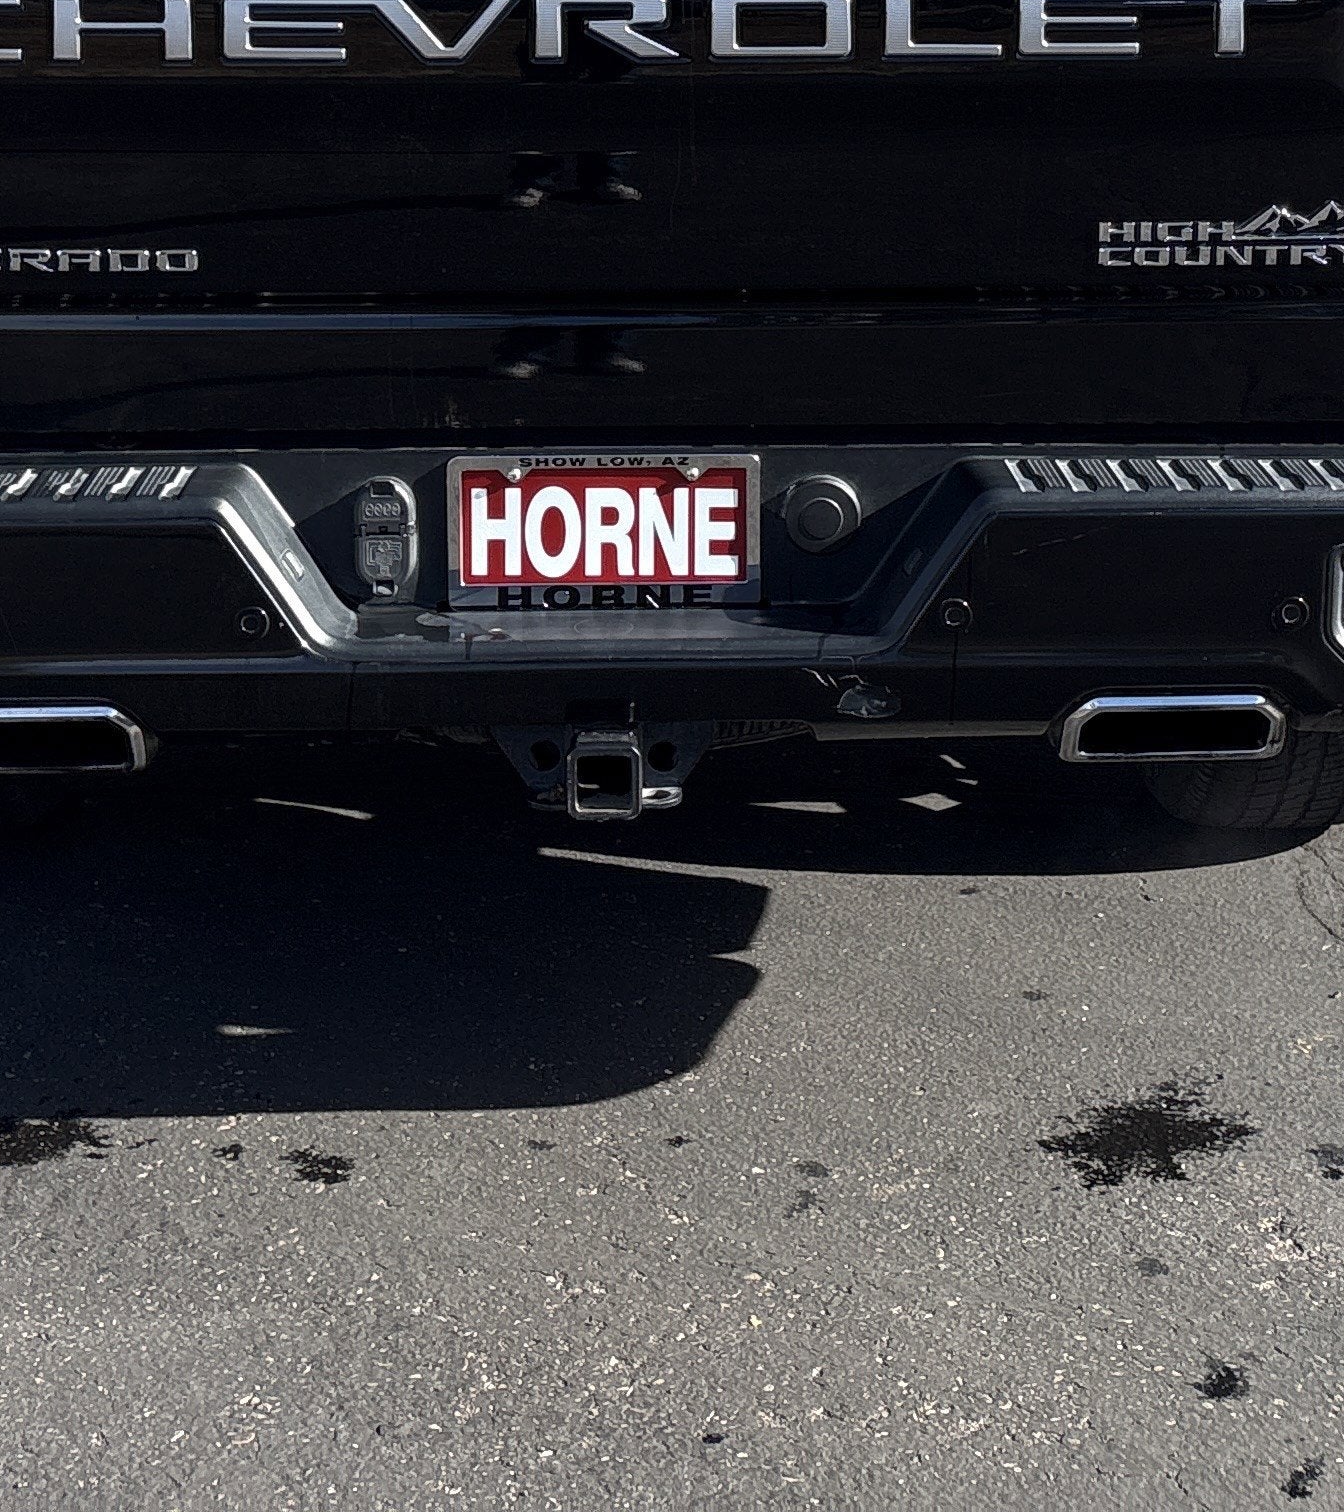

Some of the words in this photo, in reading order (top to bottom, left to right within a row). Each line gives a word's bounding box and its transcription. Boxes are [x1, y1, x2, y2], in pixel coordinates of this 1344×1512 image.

[1098, 221, 1235, 242] HIGH
[519, 456, 587, 467] SHOW
[597, 456, 651, 467] LOW,
[661, 456, 690, 466] AZ
[470, 485, 739, 578] HORNE
[497, 585, 713, 609] HORNE
